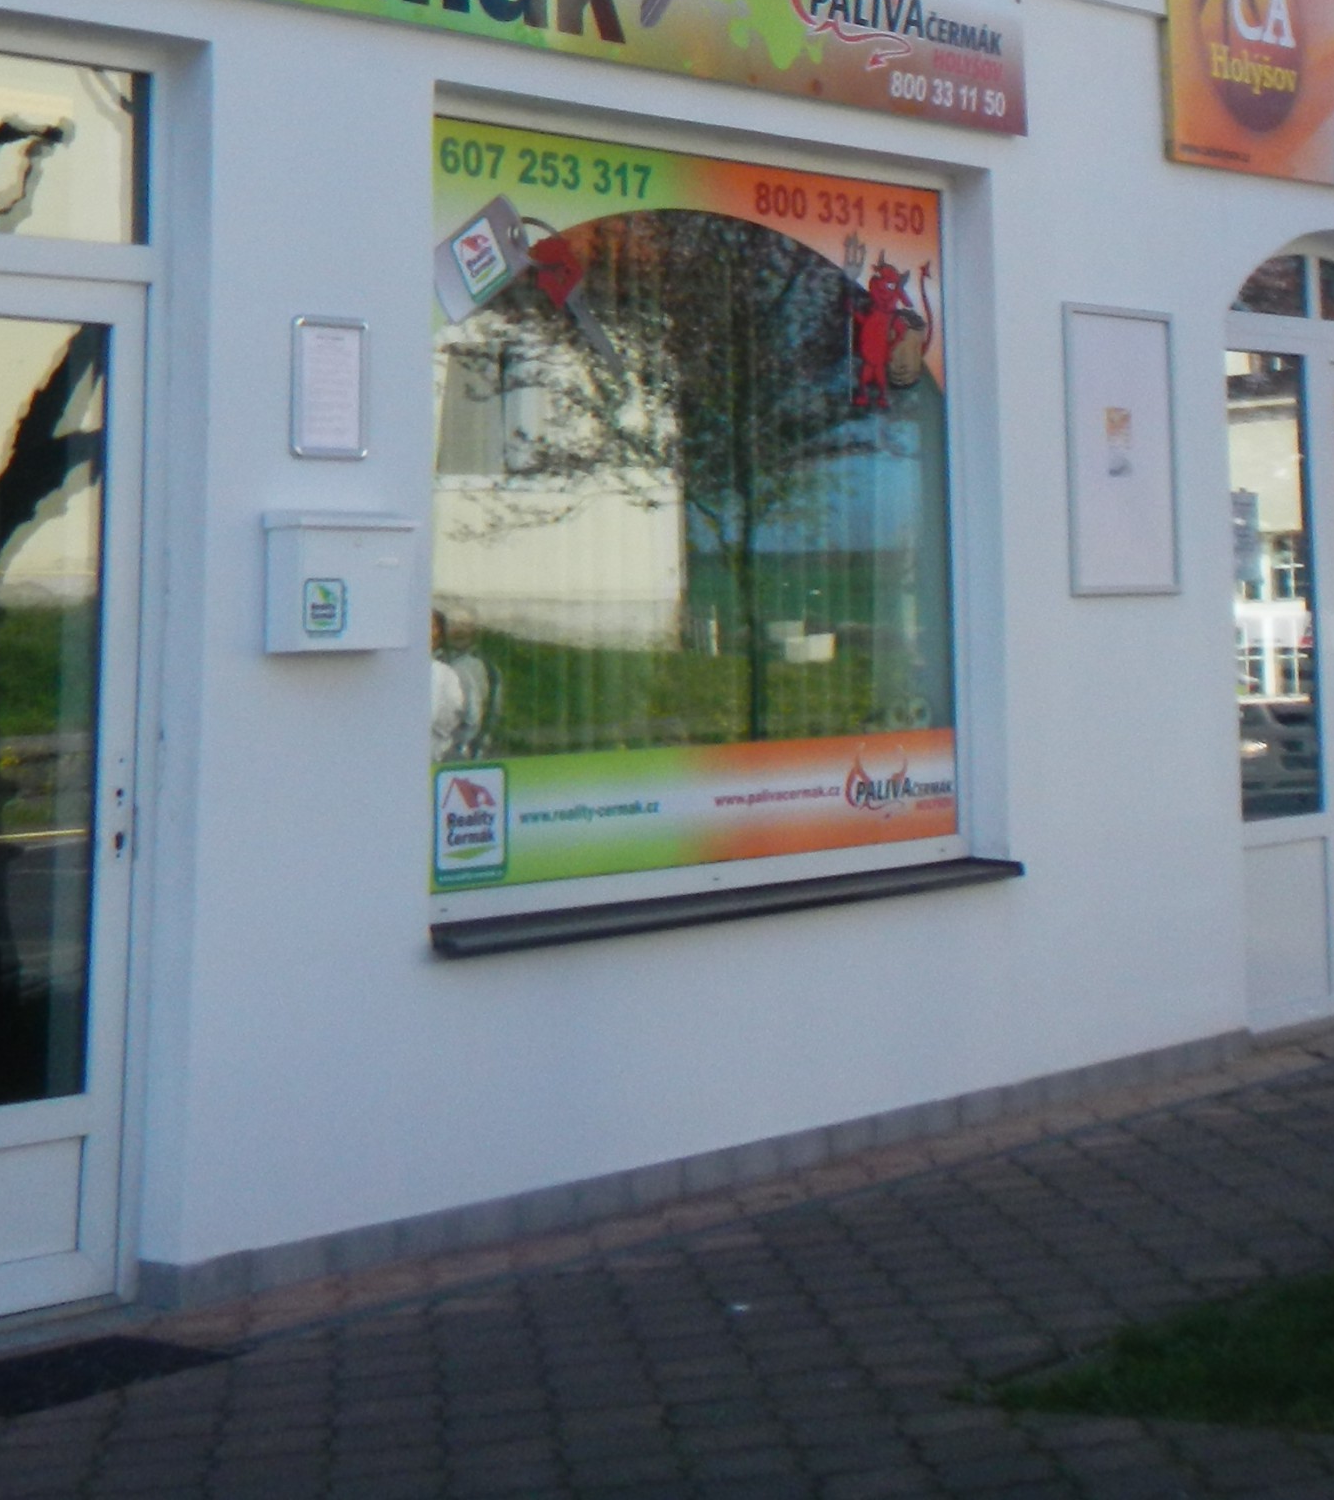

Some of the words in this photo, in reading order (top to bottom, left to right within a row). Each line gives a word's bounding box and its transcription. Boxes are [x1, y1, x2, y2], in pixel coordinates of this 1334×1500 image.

[925, 10, 1003, 56] ČERMÁK
[890, 70, 927, 102] 800
[932, 78, 954, 108] 33
[958, 85, 977, 112] 11
[984, 89, 1006, 117] 50
[1210, 42, 1298, 96] Holýšov
[440, 137, 506, 180] 607
[518, 148, 581, 192] 253
[593, 159, 652, 199] 317
[754, 181, 807, 219] 800
[818, 189, 865, 228] 331
[877, 200, 925, 237] 150
